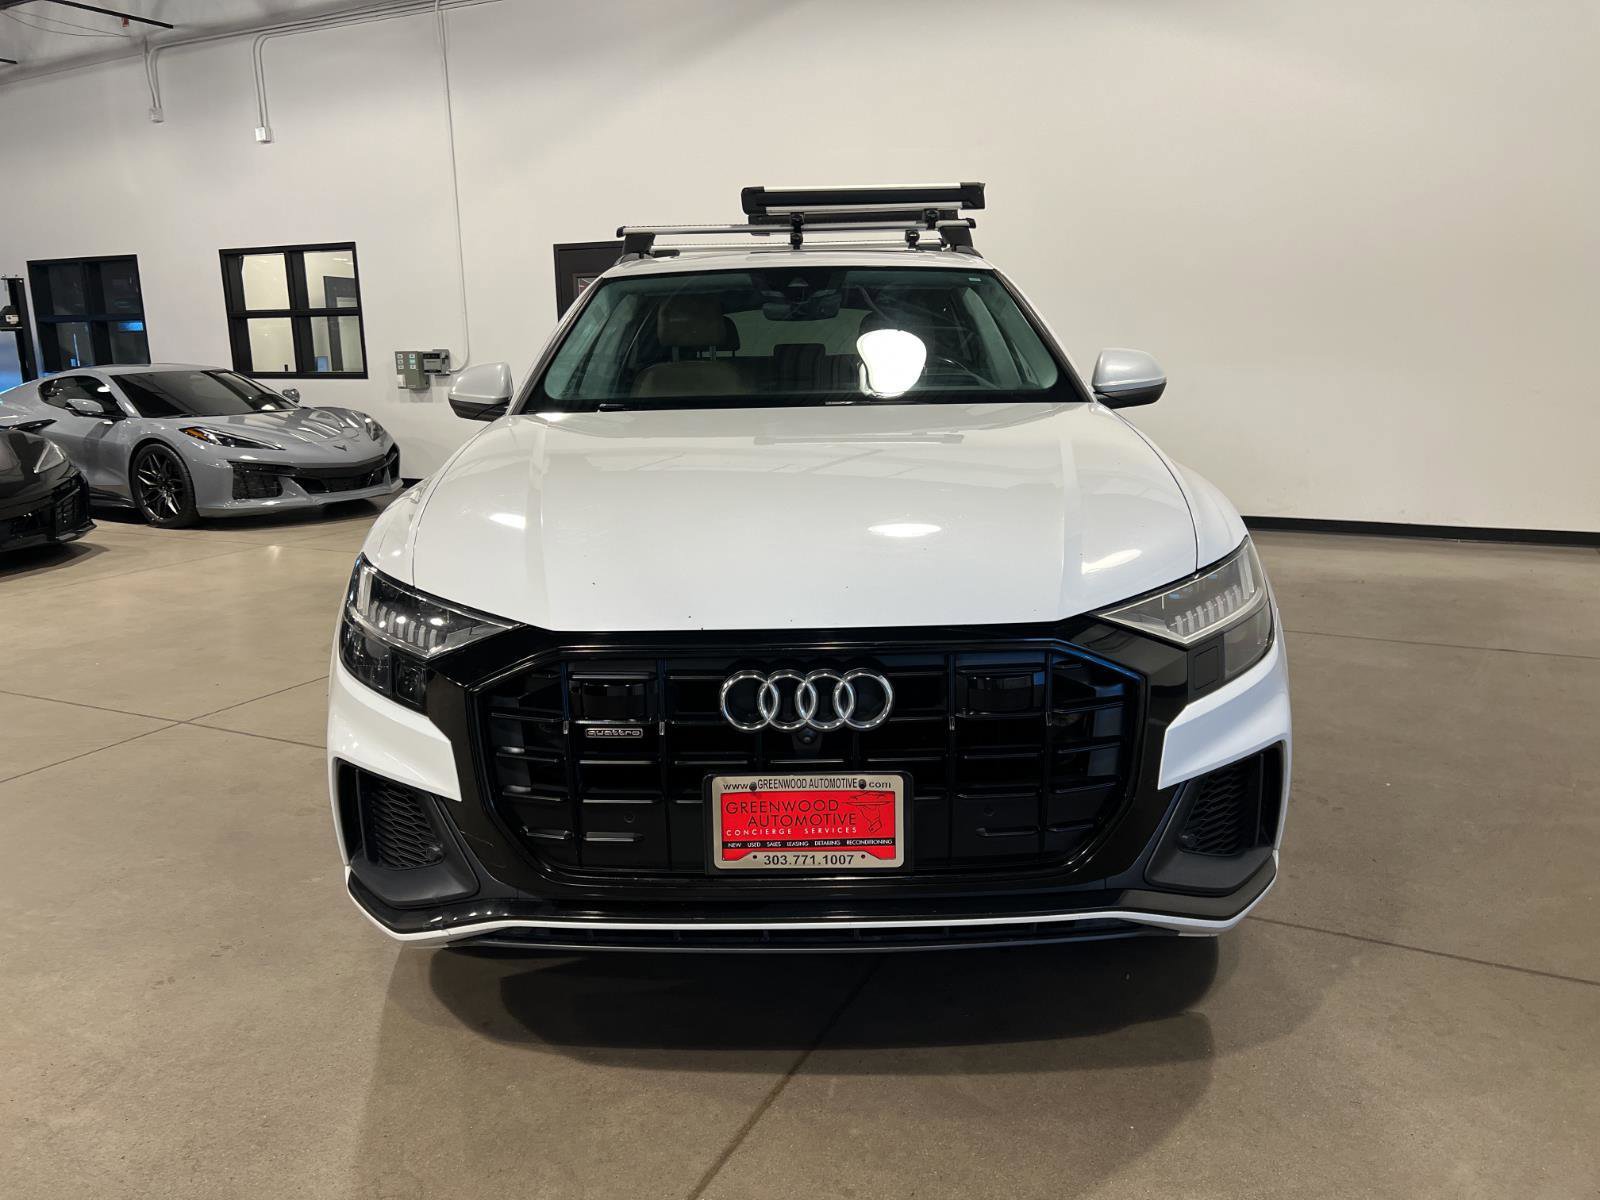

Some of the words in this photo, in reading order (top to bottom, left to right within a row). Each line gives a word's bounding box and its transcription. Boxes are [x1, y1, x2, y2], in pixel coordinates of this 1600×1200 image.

[587, 729, 640, 737] quattro
[757, 779, 807, 789] GREENWOOD
[809, 778, 858, 788] AUTOMOTIVE
[725, 800, 839, 814] GREENWOOD
[748, 813, 856, 827] AUTOMOTIVE
[726, 828, 792, 836] CONCIERGE
[763, 855, 854, 865] 303.771.1007
